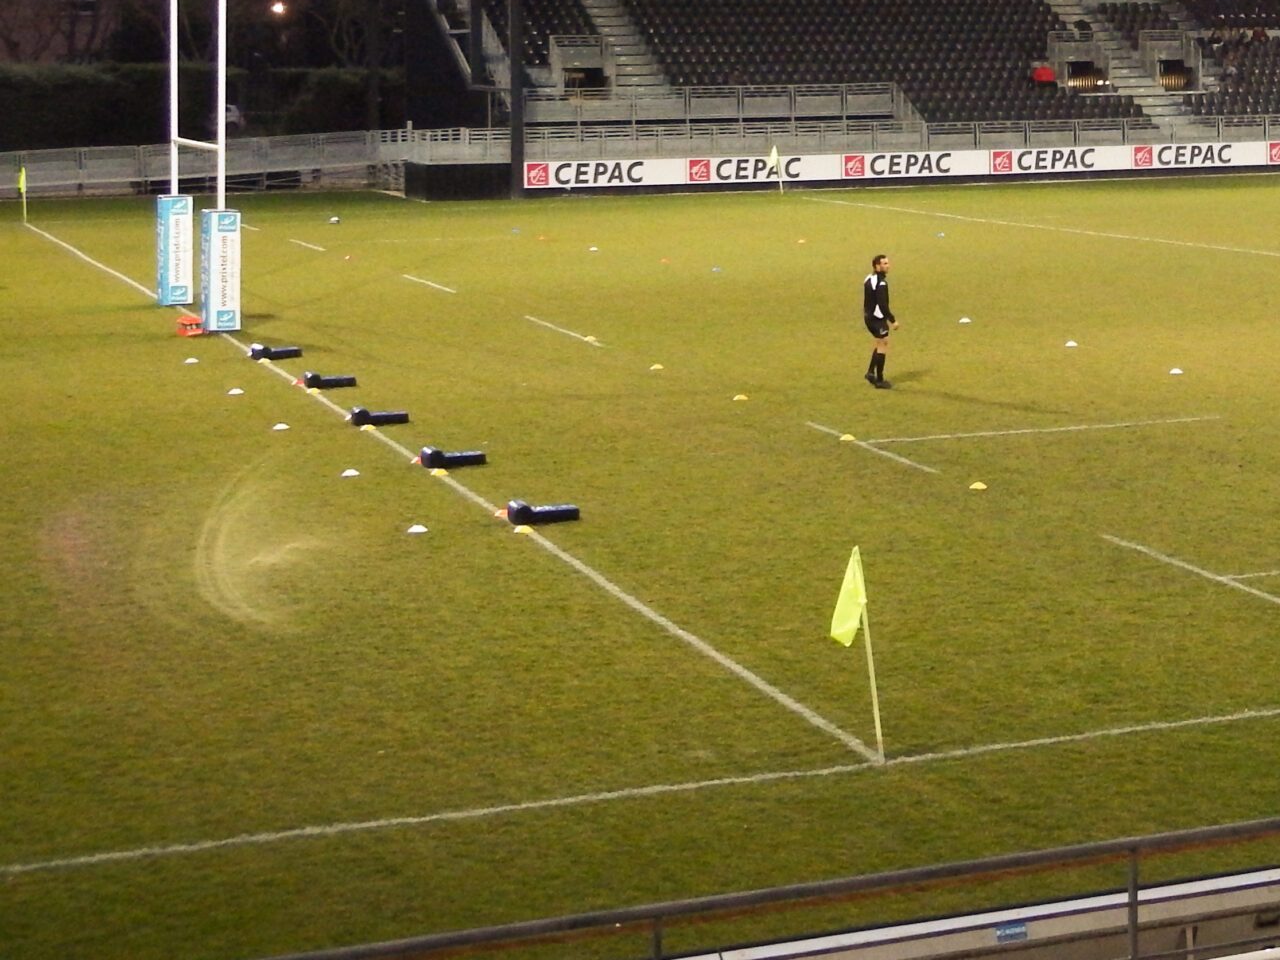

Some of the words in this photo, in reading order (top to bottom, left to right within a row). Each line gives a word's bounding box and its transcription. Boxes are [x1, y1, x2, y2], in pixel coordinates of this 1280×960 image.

[870, 153, 951, 175] CEPAC
[1018, 149, 1095, 170] CEPAC
[1158, 145, 1231, 165] CEPAC
[555, 161, 643, 185] CEPAC
[716, 158, 801, 180] CEPAC
